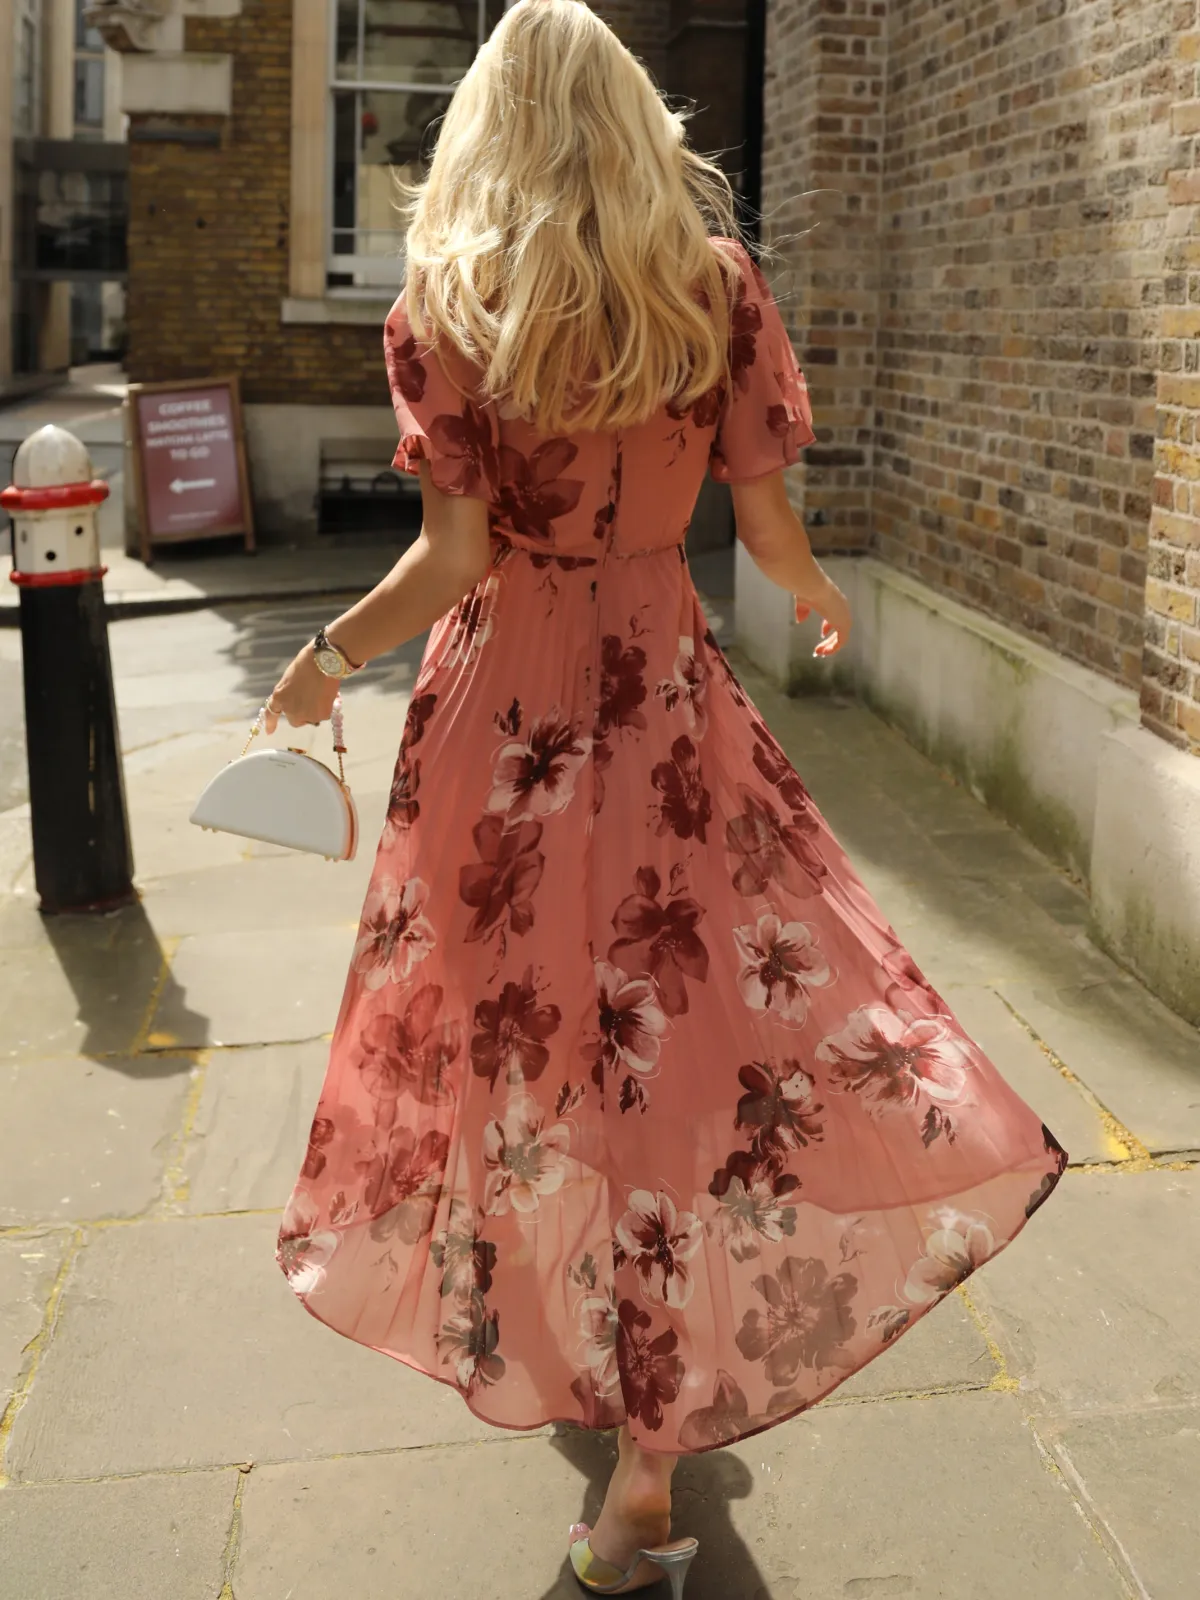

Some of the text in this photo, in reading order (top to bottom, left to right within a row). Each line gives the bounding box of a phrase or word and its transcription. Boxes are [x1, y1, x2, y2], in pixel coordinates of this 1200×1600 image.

[158, 399, 211, 416] COFFEE
[170, 445, 210, 460] TO GO
